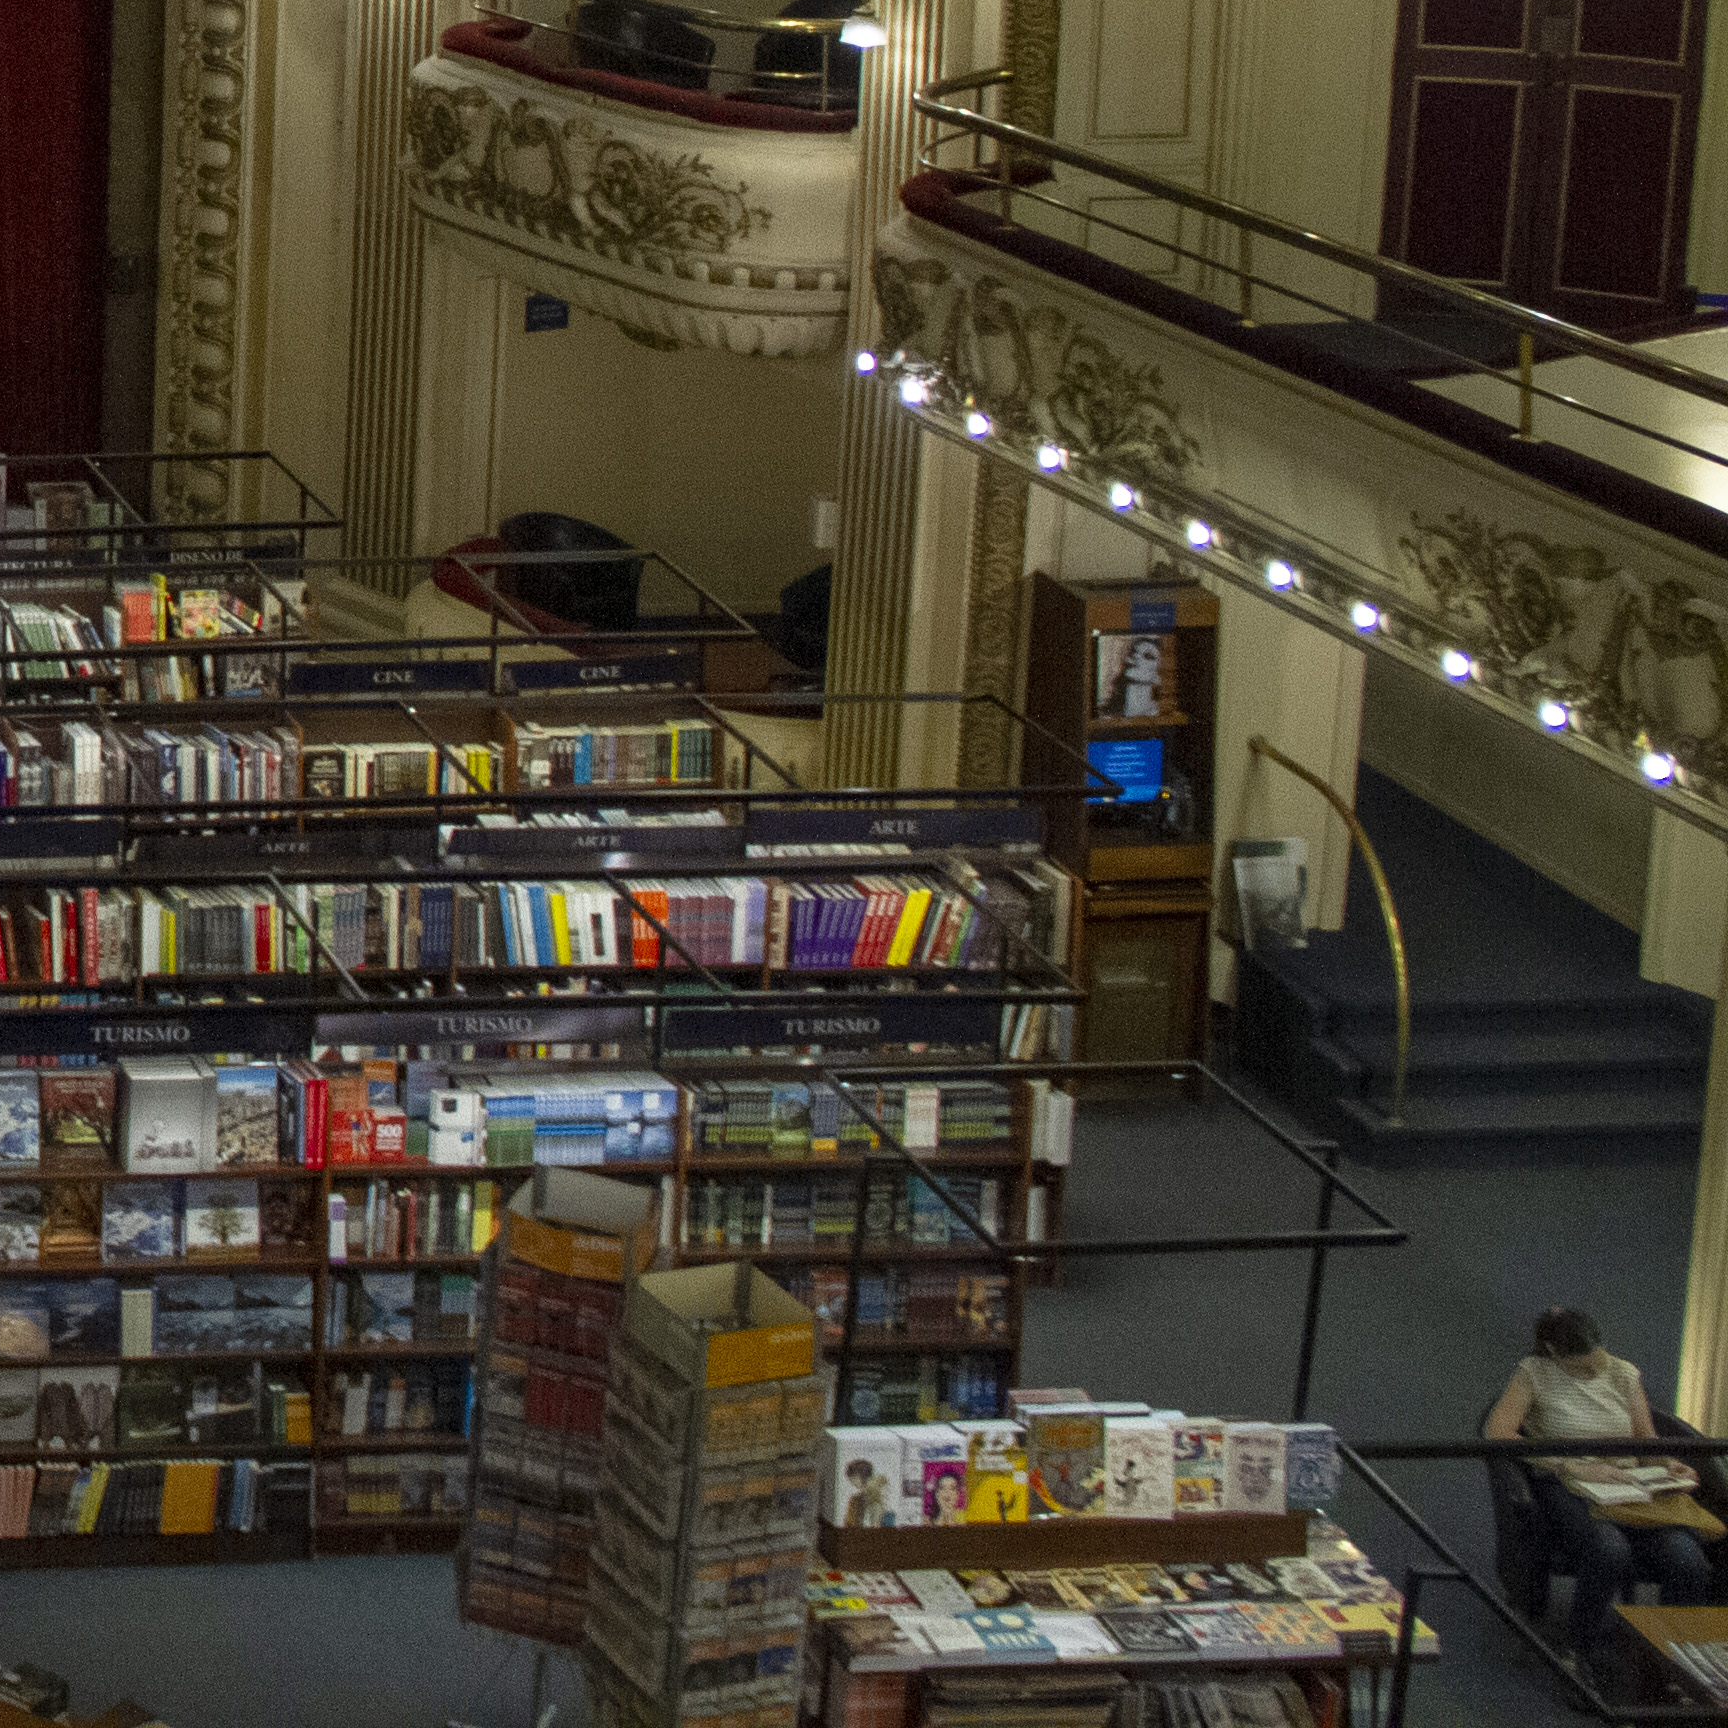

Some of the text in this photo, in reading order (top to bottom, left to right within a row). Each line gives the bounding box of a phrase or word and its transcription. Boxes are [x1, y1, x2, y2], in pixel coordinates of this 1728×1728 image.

[373, 670, 413, 684] CINE
[580, 666, 619, 680] CINE
[870, 819, 918, 834] ARTE
[575, 834, 620, 848] ARTE
[435, 1015, 533, 1035] TURISMO
[783, 1018, 880, 1035] TURISMO
[92, 1026, 191, 1043] TURISMO
